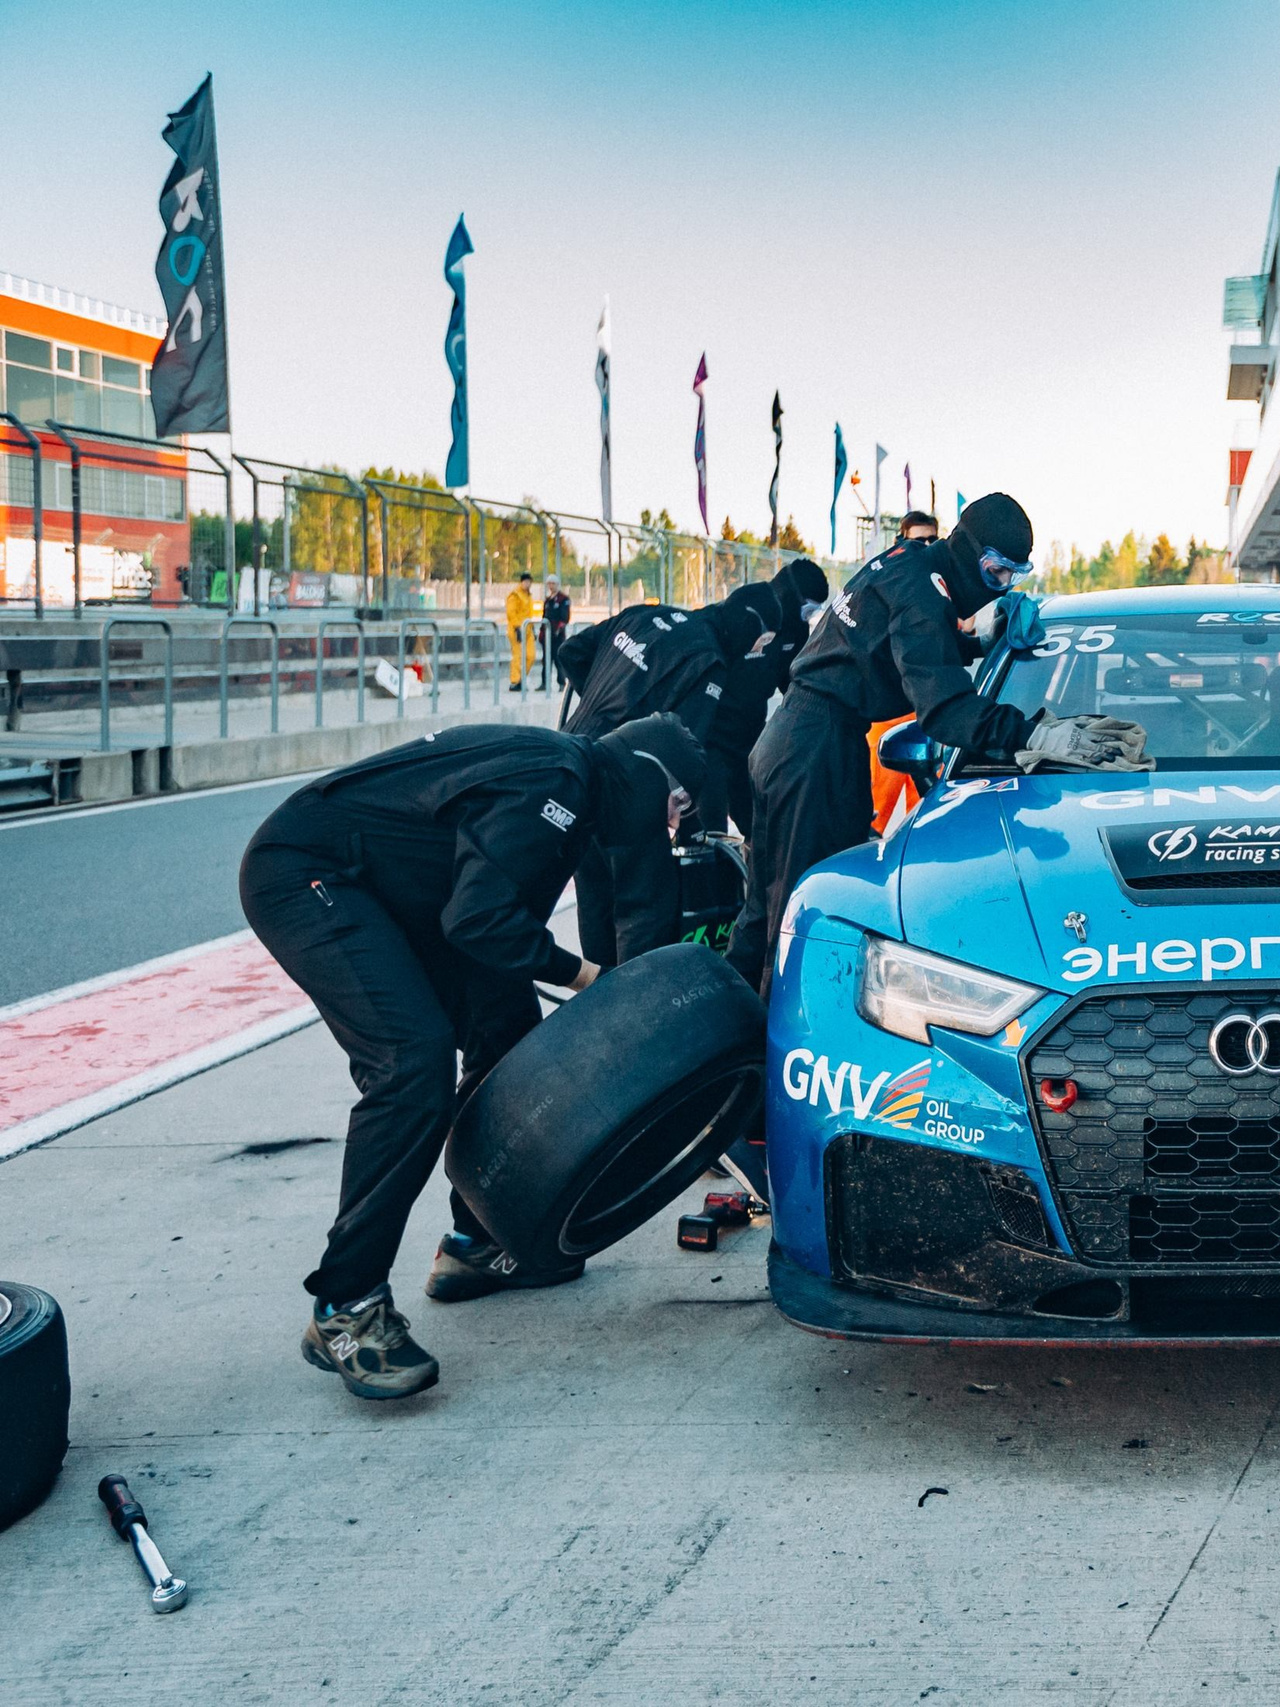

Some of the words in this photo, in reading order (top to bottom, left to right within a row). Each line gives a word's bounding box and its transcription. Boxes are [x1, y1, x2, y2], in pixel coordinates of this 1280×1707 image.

[1032, 624, 1118, 658] 55
[543, 802, 574, 827] OMP
[1204, 846, 1266, 864] racing
[783, 1048, 892, 1121] GNV
[926, 1099, 954, 1120] OIL
[924, 1120, 985, 1145] GROUP
